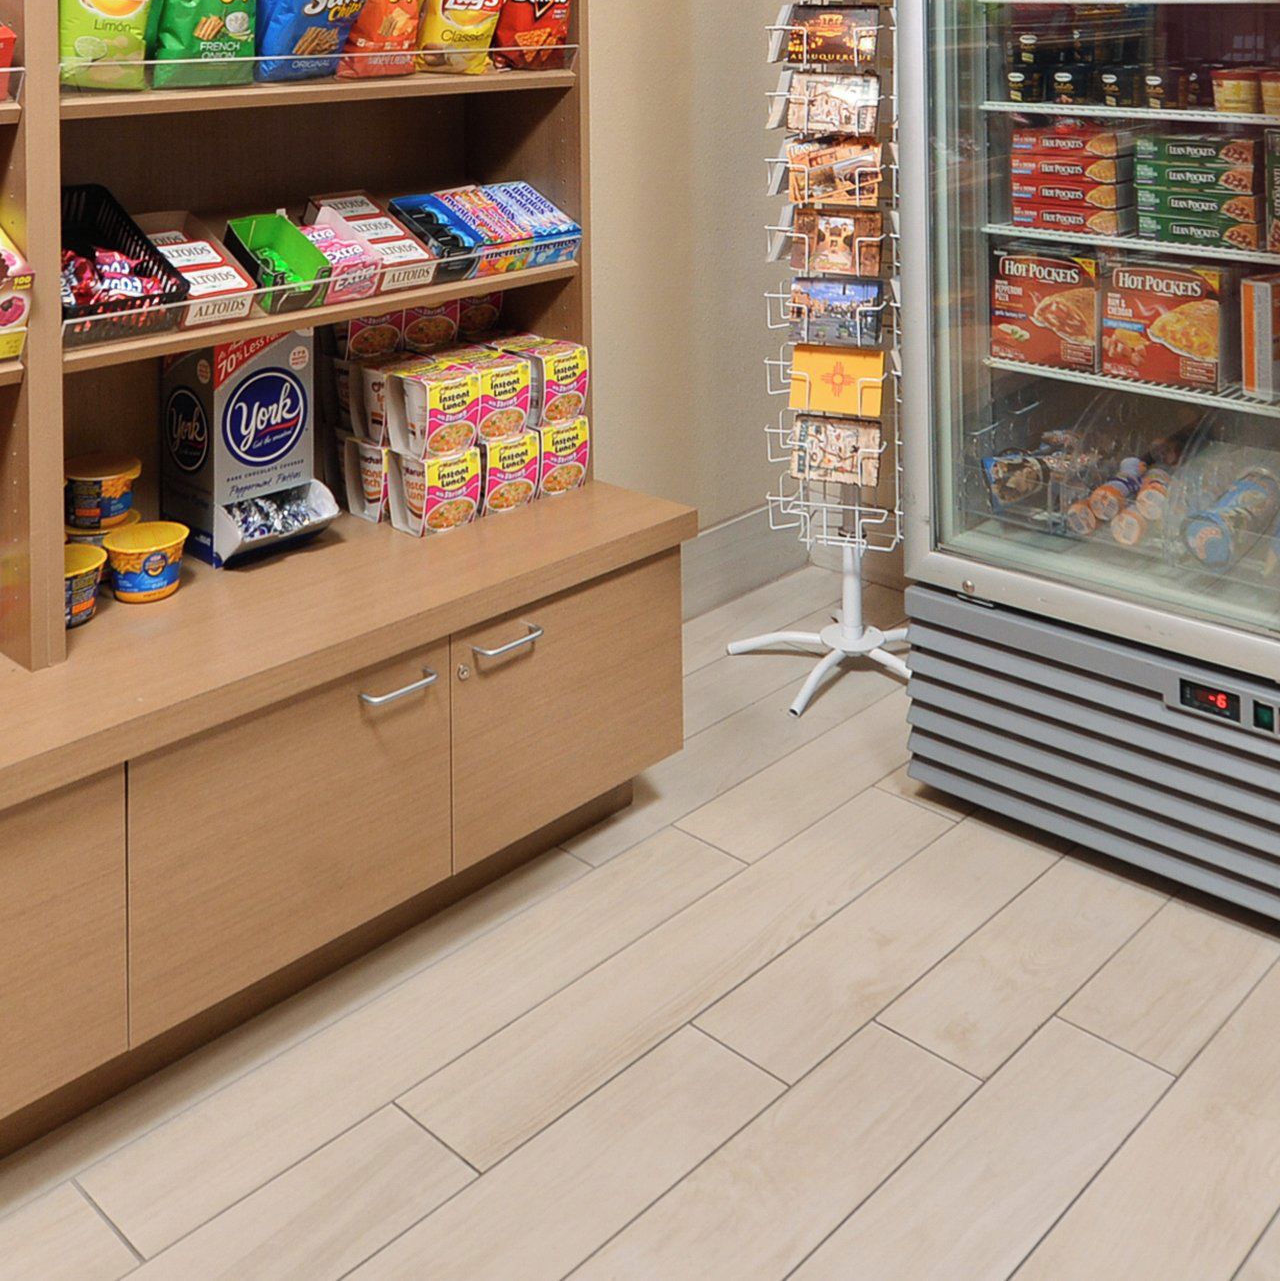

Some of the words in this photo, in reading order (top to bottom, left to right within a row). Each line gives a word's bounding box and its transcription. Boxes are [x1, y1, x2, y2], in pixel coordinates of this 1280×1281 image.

[328, 1, 363, 22] Chips
[94, 19, 132, 31] Limón
[440, 28, 485, 44] Classic
[199, 41, 240, 52] FRENCH
[291, 58, 331, 69] ORIGINAL
[1055, 138, 1084, 150] POCKETS
[520, 183, 556, 214] mentos
[444, 195, 478, 228] mentos
[325, 244, 364, 263] Extra
[13, 275, 32, 285] 100
[387, 267, 432, 283] ALTOIDS
[1004, 259, 1026, 277] HOT
[1026, 261, 1080, 284] POCKETS
[335, 271, 375, 292] Extra
[1117, 271, 1144, 290] HOT
[1144, 274, 1202, 298] POCKETS
[194, 299, 247, 318] ALTOIDS
[219, 352, 244, 380] 70%
[243, 337, 266, 360] Less
[235, 382, 303, 453] York
[244, 466, 279, 479] CHOCOLATE
[229, 477, 273, 499] Peppermint
[1207, 693, 1228, 710] -6
